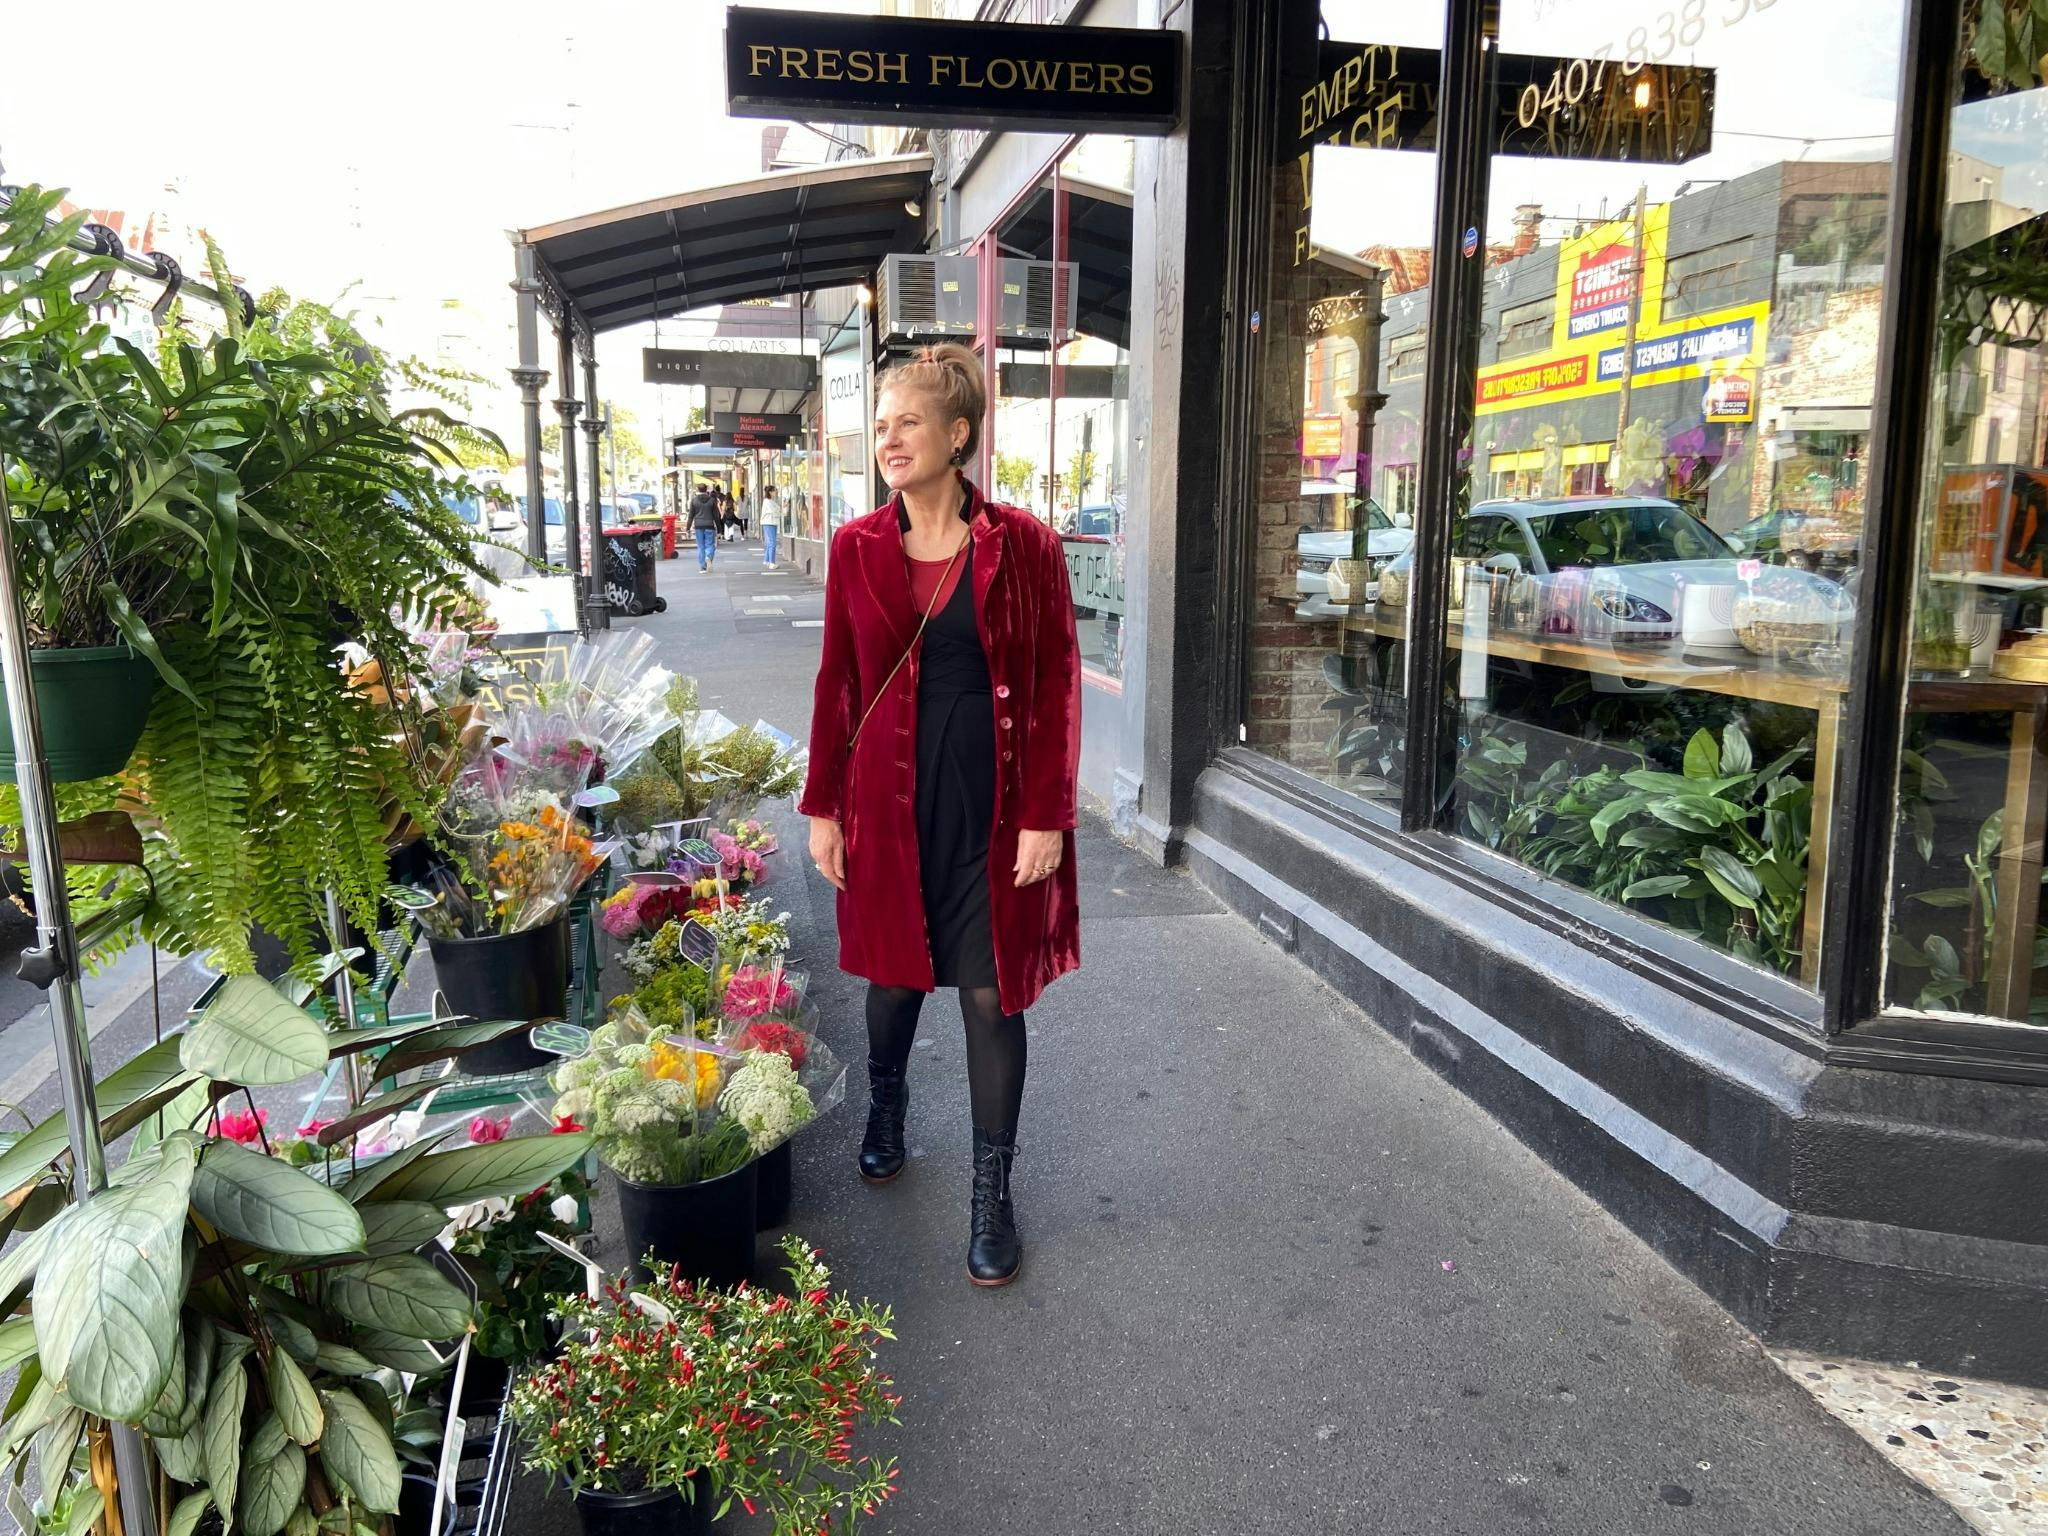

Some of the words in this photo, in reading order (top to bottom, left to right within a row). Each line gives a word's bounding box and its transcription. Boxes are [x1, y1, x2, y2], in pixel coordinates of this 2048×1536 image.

[746, 44, 908, 84] FRESH
[928, 55, 1154, 95] FLOWERS
[1518, 42, 1614, 128] 0407
[1621, 0, 1706, 76] 838
[707, 338, 788, 353] COLLARTS
[829, 373, 862, 400] COLLA
[740, 424, 776, 432] Alexander
